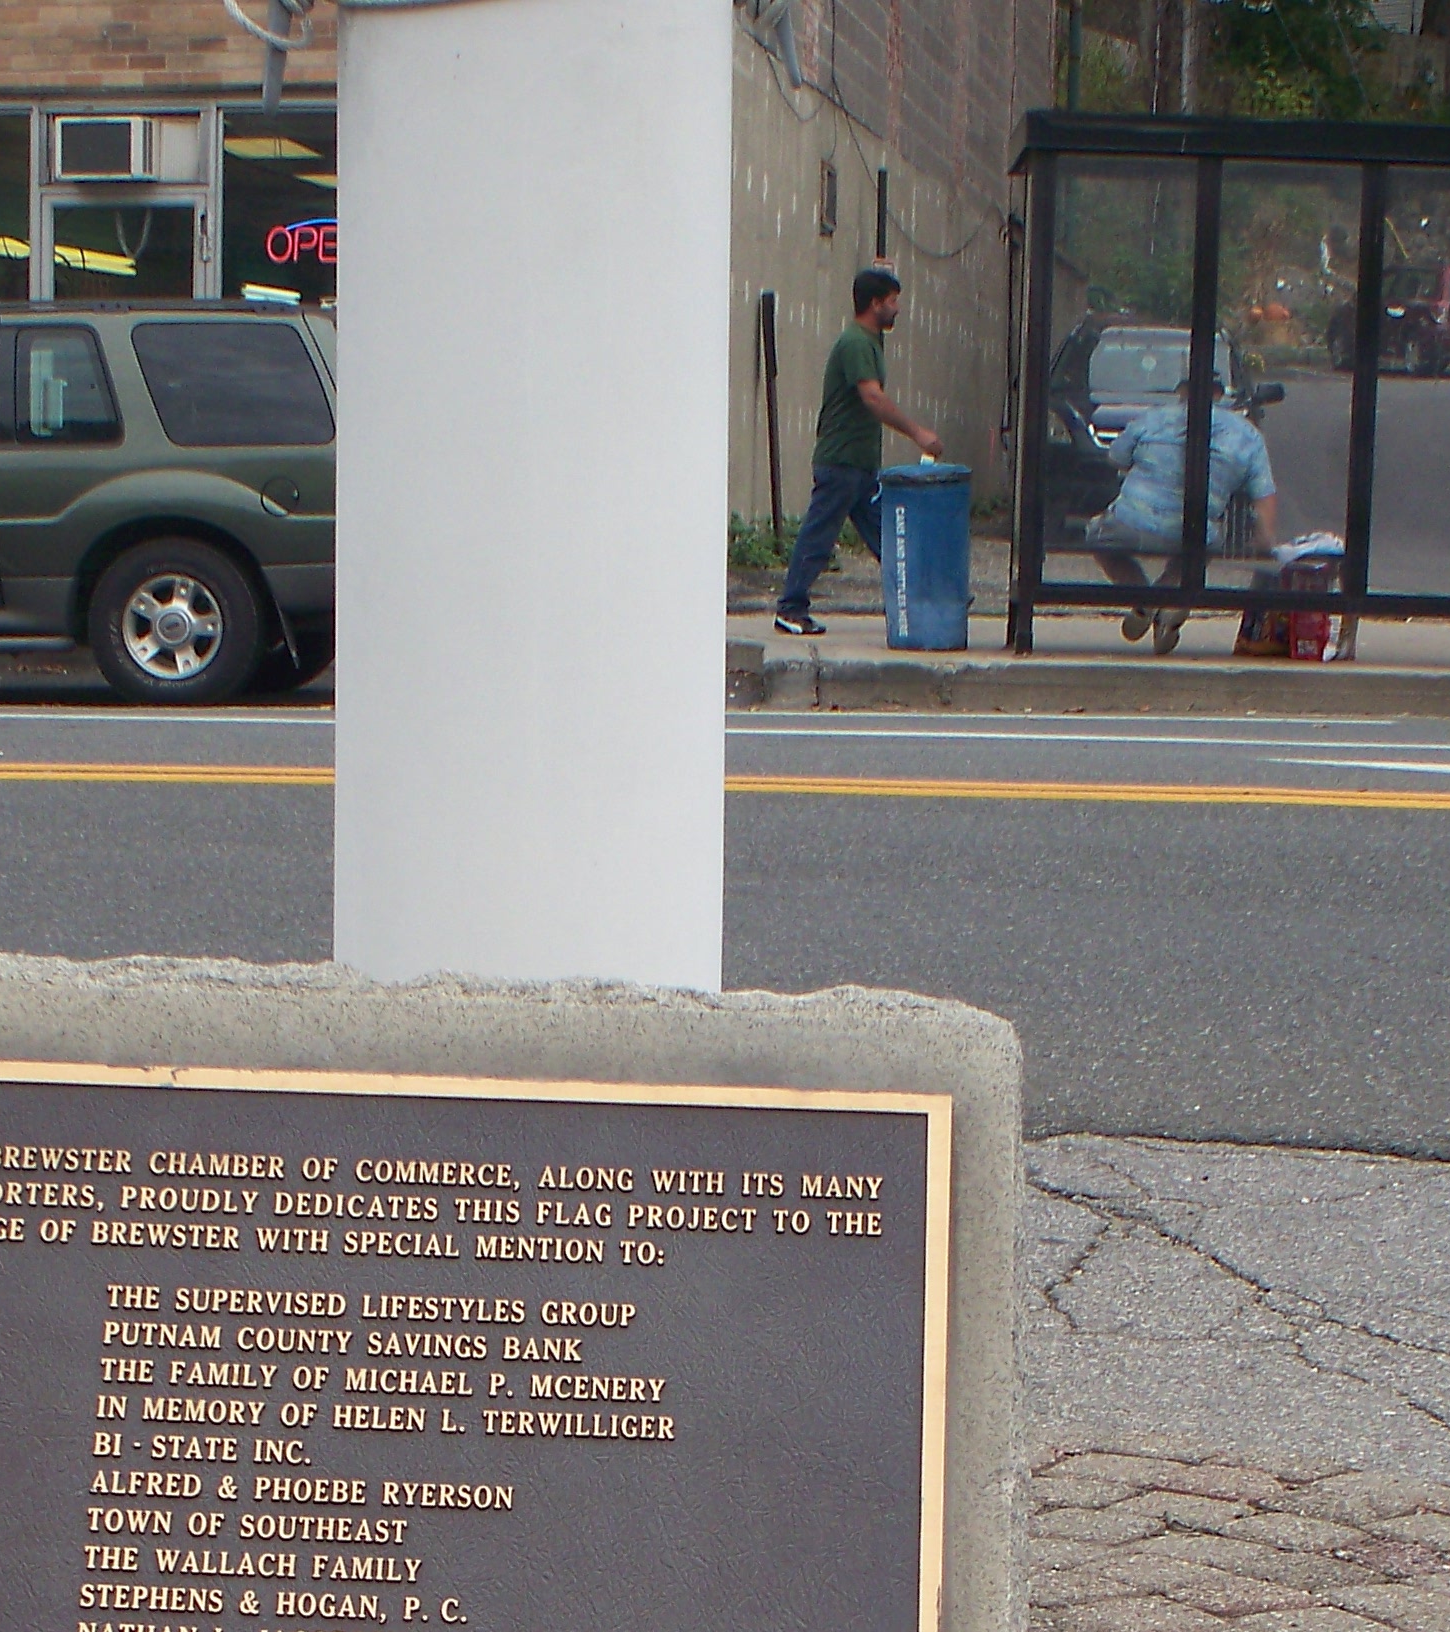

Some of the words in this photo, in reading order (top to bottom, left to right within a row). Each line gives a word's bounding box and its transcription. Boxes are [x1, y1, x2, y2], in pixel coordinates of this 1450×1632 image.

[266, 225, 338, 263] OPE
[895, 506, 906, 535] CANS
[896, 536, 907, 560] AND
[897, 561, 907, 609] BOTTLES
[148, 1150, 285, 1179] CHAMBER
[301, 1156, 339, 1181] OF
[354, 1157, 521, 1192] COMMERCE,
[537, 1163, 634, 1192] ALONG
[651, 1168, 725, 1195] WITH
[741, 1171, 785, 1197] ITS
[800, 1173, 884, 1200] MANY
[119, 1184, 260, 1214] PROUDLY
[273, 1190, 439, 1221] DEDICATES
[453, 1196, 521, 1224] THIS
[535, 1199, 612, 1227] FLAG
[627, 1203, 758, 1232] PROJECT
[772, 1208, 811, 1234] TO
[825, 1209, 883, 1236] THE
[38, 1217, 78, 1243] OF
[90, 1219, 240, 1250] BREWSTER
[254, 1226, 330, 1253] WITH
[342, 1228, 461, 1258] SPECIAL
[474, 1233, 605, 1263] MENTION
[619, 1238, 665, 1266] TO:
[106, 1283, 161, 1310] THE
[174, 1286, 348, 1317] SUPERVISED
[361, 1292, 526, 1324] LIFESTYLES
[540, 1298, 637, 1327] GROUP
[102, 1318, 223, 1349] PUTNAM
[236, 1325, 354, 1354] COUNTY
[366, 1330, 488, 1360] SAVINGS
[502, 1334, 583, 1362] BANK
[99, 1356, 155, 1384] THE
[168, 1359, 278, 1388] FAMILY
[291, 1364, 330, 1390] OF
[343, 1366, 474, 1396] MICHAEL
[488, 1371, 514, 1398] P.
[529, 1372, 667, 1402] MCENERY
[95, 1393, 129, 1419] IN
[141, 1395, 266, 1425] MEMORY
[279, 1401, 319, 1427] OF
[332, 1403, 427, 1432] HELEN
[440, 1407, 466, 1433] L.
[482, 1408, 676, 1440] TERWILLIGER
[252, 1437, 312, 1465] INC.
[89, 1468, 203, 1498] ALFRED
[216, 1473, 239, 1500] &
[253, 1475, 367, 1505] PHOEBE
[381, 1480, 515, 1510] RYERSON
[86, 1506, 173, 1535] TOWN
[187, 1510, 226, 1537] OF
[239, 1512, 409, 1544] SOUTHEAST
[83, 1543, 140, 1572] THE
[154, 1547, 298, 1578] WALLACH
[311, 1553, 423, 1583] FAMILY
[78, 1582, 224, 1614] STEPHENS
[238, 1588, 261, 1616] &
[274, 1590, 388, 1625] HOGAN,
[402, 1595, 430, 1621] P.
[440, 1596, 468, 1623] C.
